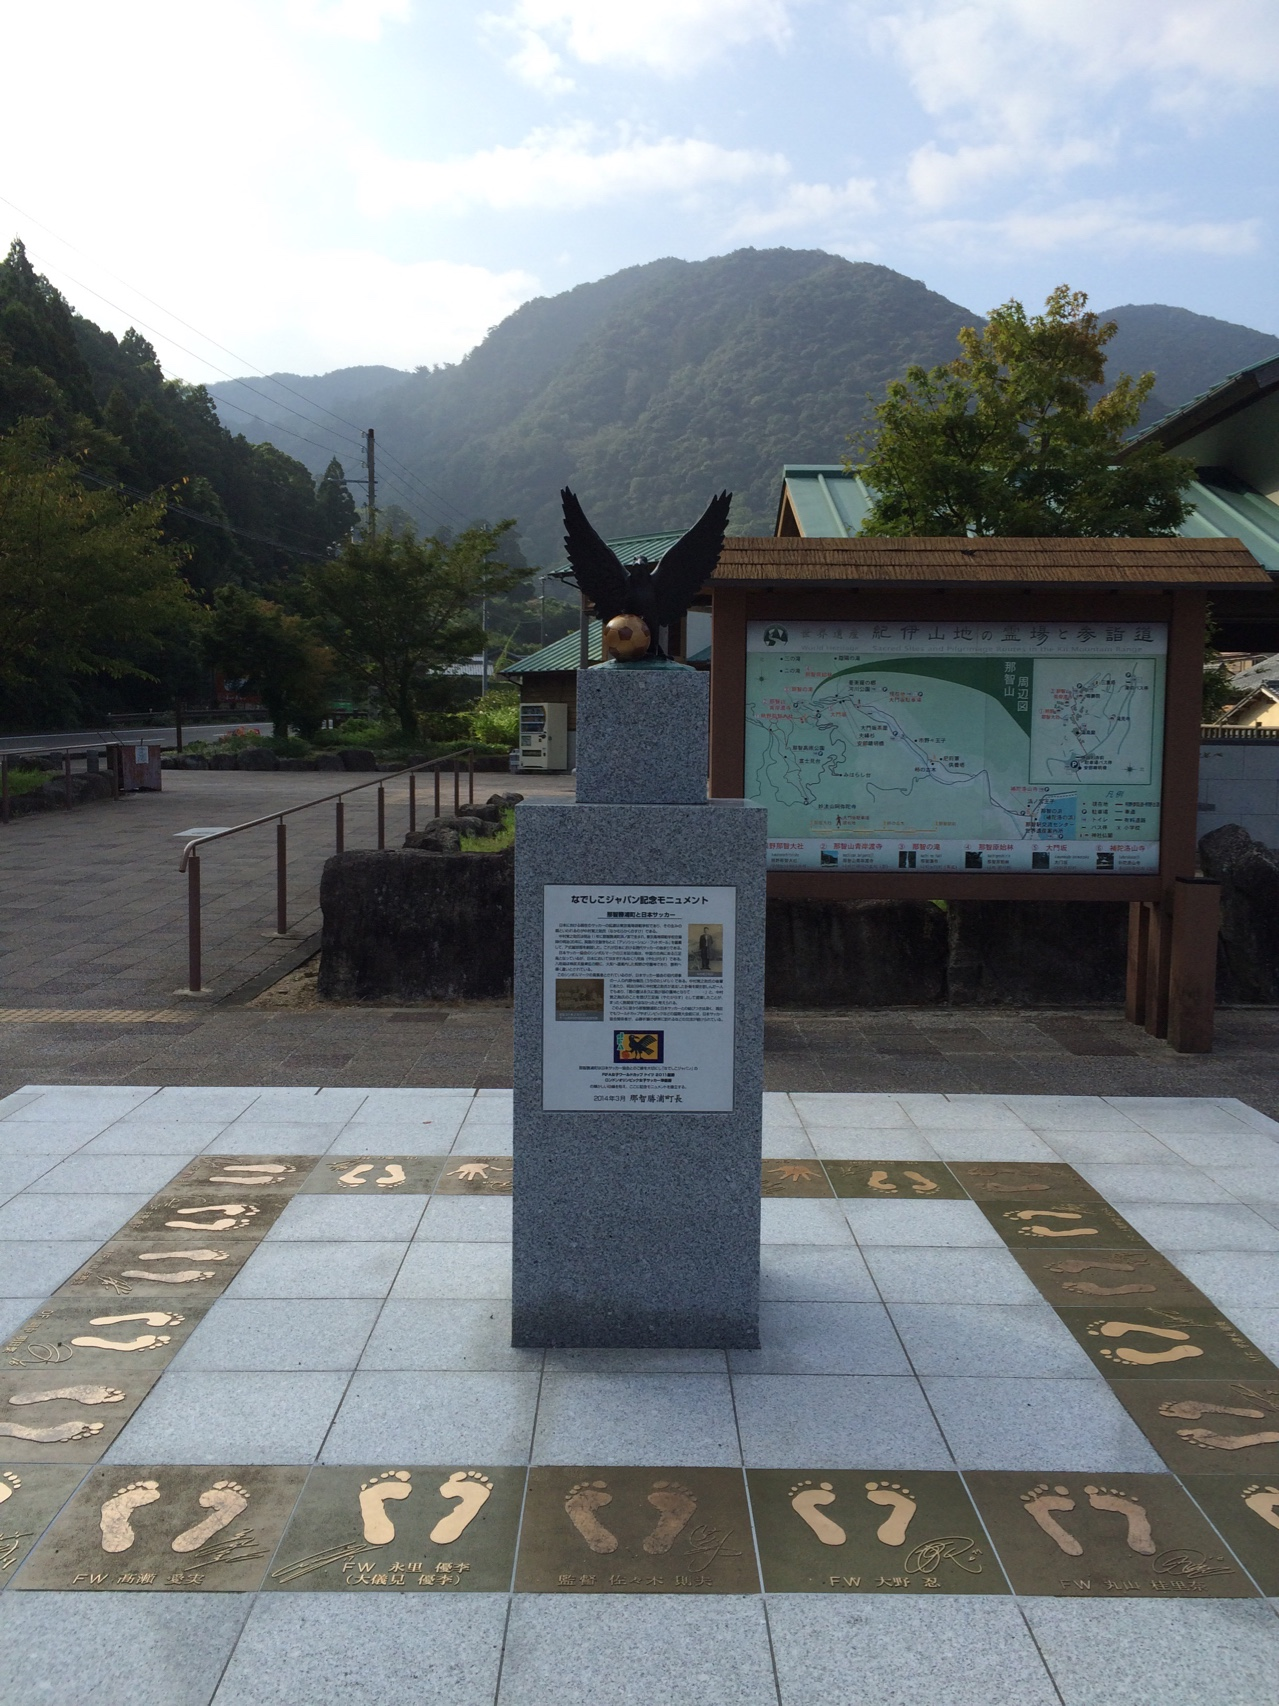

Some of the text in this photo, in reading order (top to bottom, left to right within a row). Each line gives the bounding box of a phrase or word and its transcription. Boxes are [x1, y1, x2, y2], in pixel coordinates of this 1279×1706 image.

[800, 625, 1154, 646] 世界遺産 紀伊山地の霊場と参詣道
[1004, 662, 1016, 697] 那智山
[1017, 676, 1029, 712] 周辺図
[1105, 790, 1124, 798] 凡例
[767, 842, 804, 850] 野那智大社
[571, 895, 709, 905] なでしこジャパン記念モニュメント
[629, 1094, 683, 1103] 那智勝浦町長
[342, 1562, 472, 1574] FW 永里 優季
[72, 1573, 108, 1584] FW
[163, 1572, 206, 1586] 愛実
[557, 1574, 714, 1588] 監督 佐々木 則夫
[829, 1576, 941, 1589] FW 大野 忍
[1059, 1579, 1209, 1592] FW 丸山 桂里奈
